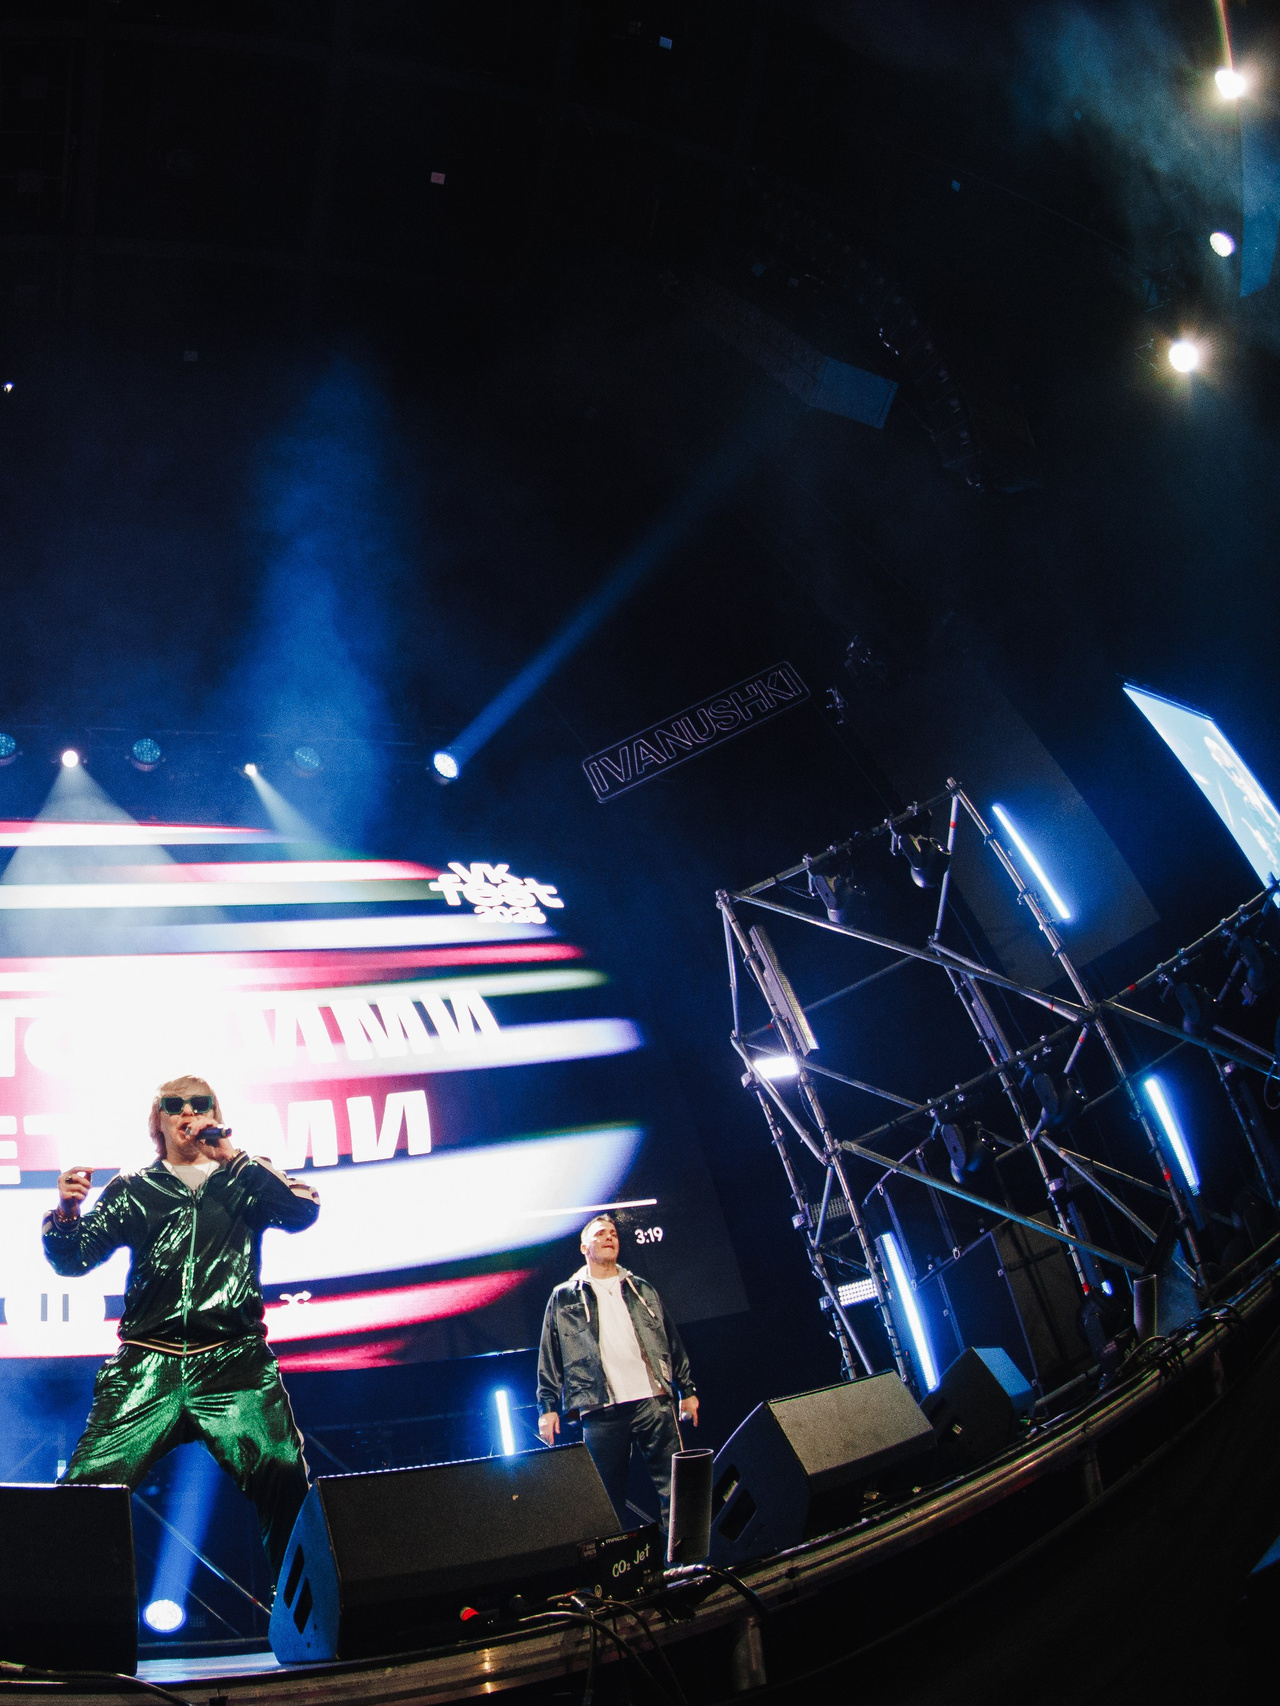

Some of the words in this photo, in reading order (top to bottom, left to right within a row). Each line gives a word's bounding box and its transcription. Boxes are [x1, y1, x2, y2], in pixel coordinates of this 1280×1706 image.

[589, 669, 802, 792] IVANUSHKI
[634, 1226, 663, 1245] 3:19
[633, 1543, 650, 1564] Jet
